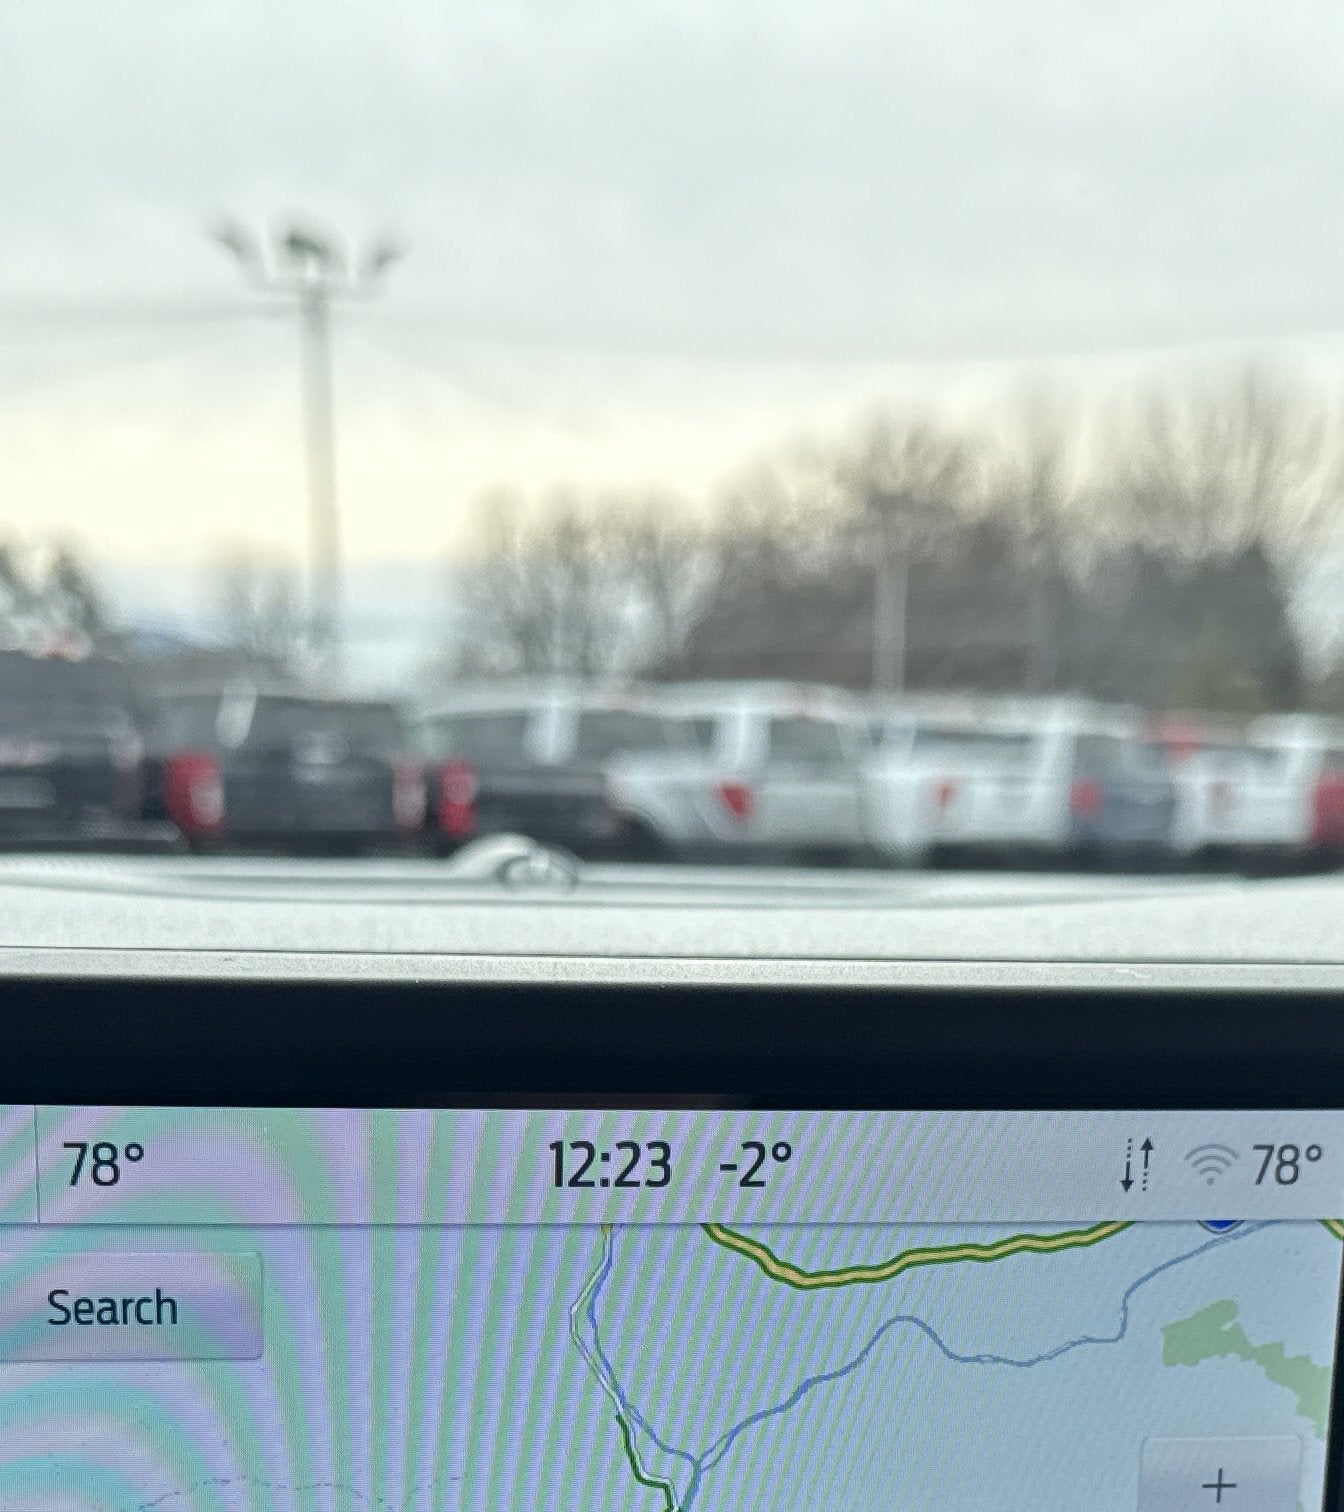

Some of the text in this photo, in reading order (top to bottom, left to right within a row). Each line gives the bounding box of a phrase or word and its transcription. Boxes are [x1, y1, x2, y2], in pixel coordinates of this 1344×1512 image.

[62, 1140, 145, 1187] 78°
[550, 1141, 793, 1187] 12:23 -2°
[1253, 1143, 1324, 1187] 78°
[47, 1288, 179, 1326] Search
